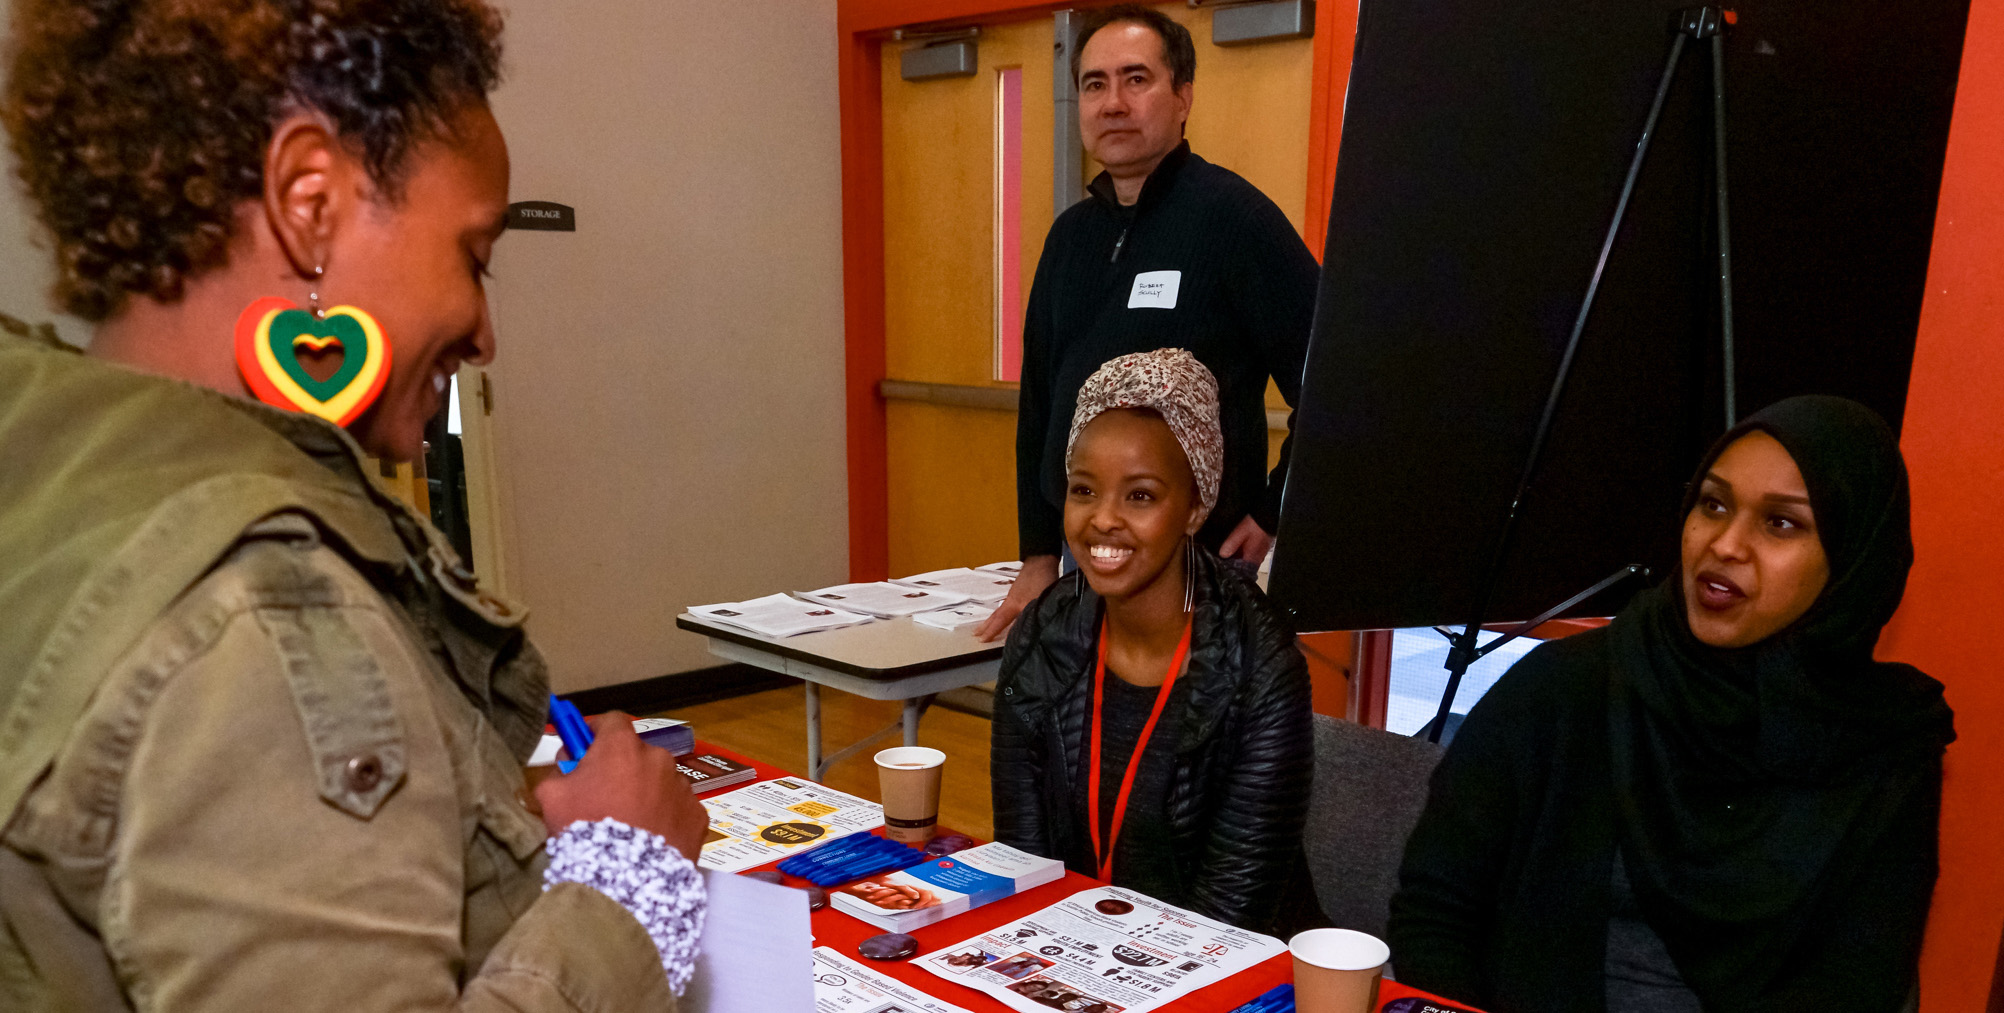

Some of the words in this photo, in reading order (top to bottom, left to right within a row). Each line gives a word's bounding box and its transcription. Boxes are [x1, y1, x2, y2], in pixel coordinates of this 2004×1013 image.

[521, 208, 561, 219] STORAGE
[675, 763, 710, 780] EASE
[1134, 896, 1153, 906] Youth
[1161, 906, 1188, 918] Success
[1158, 912, 1175, 922] The
[1173, 917, 1198, 929] Issue
[1127, 939, 1179, 961] Investment
[1129, 979, 1151, 990] $1.8
